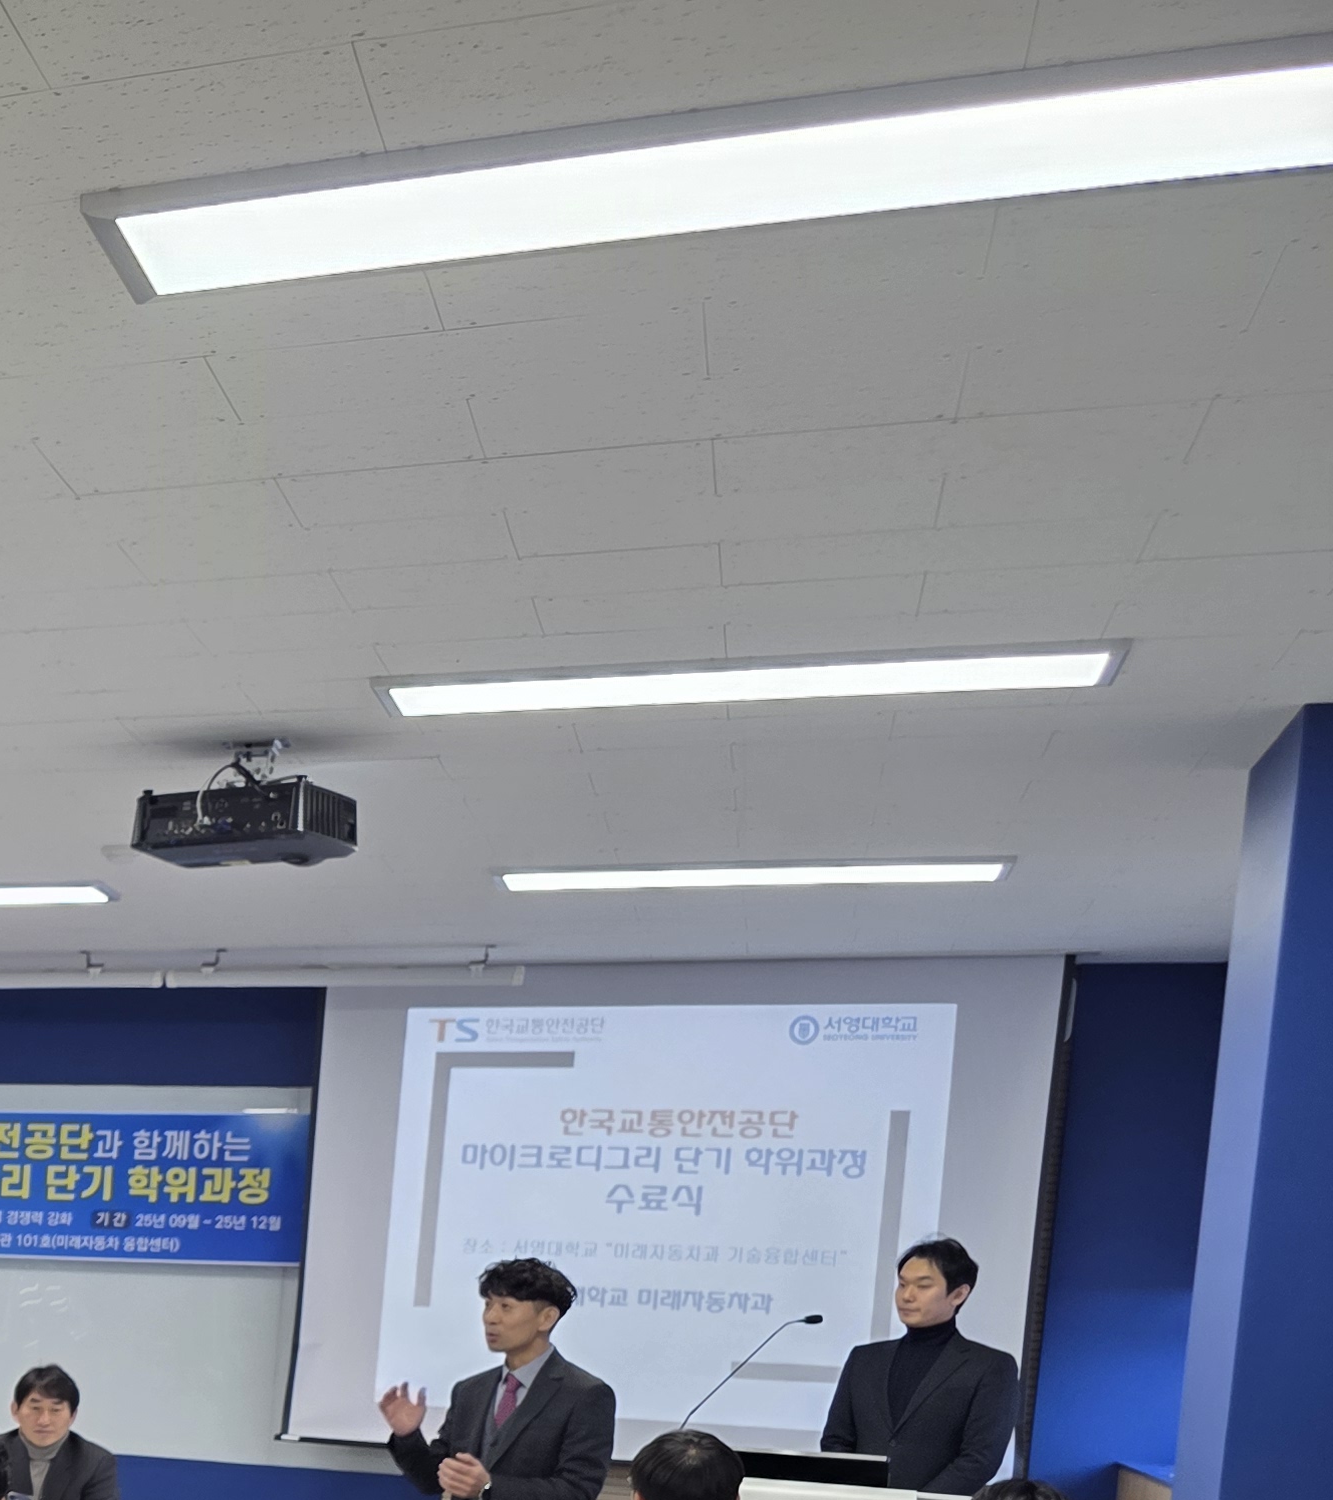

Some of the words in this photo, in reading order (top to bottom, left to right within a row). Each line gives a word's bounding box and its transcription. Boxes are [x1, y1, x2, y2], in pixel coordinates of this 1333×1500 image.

[429, 1017, 480, 1043] TS
[823, 1015, 918, 1034] 서영대학교
[559, 1107, 800, 1139] 한국교통안전공단
[132, 1128, 252, 1162] 함께하는
[460, 1143, 662, 1173] 마이크로디그리
[673, 1146, 732, 1176] 단기
[744, 1147, 868, 1179] 학위과정
[45, 1164, 114, 1201] 단기
[127, 1164, 271, 1205] 학위과정
[604, 1182, 704, 1217] 수료식
[6, 1209, 44, 1227] 경쟁력
[47, 1210, 73, 1227] 강화
[134, 1213, 166, 1230] 25년
[168, 1213, 201, 1231] 09월
[214, 1213, 247, 1231] 25년
[250, 1214, 282, 1232] 12월
[462, 1237, 494, 1255] 장소
[636, 1287, 774, 1316] 미래자동차과
